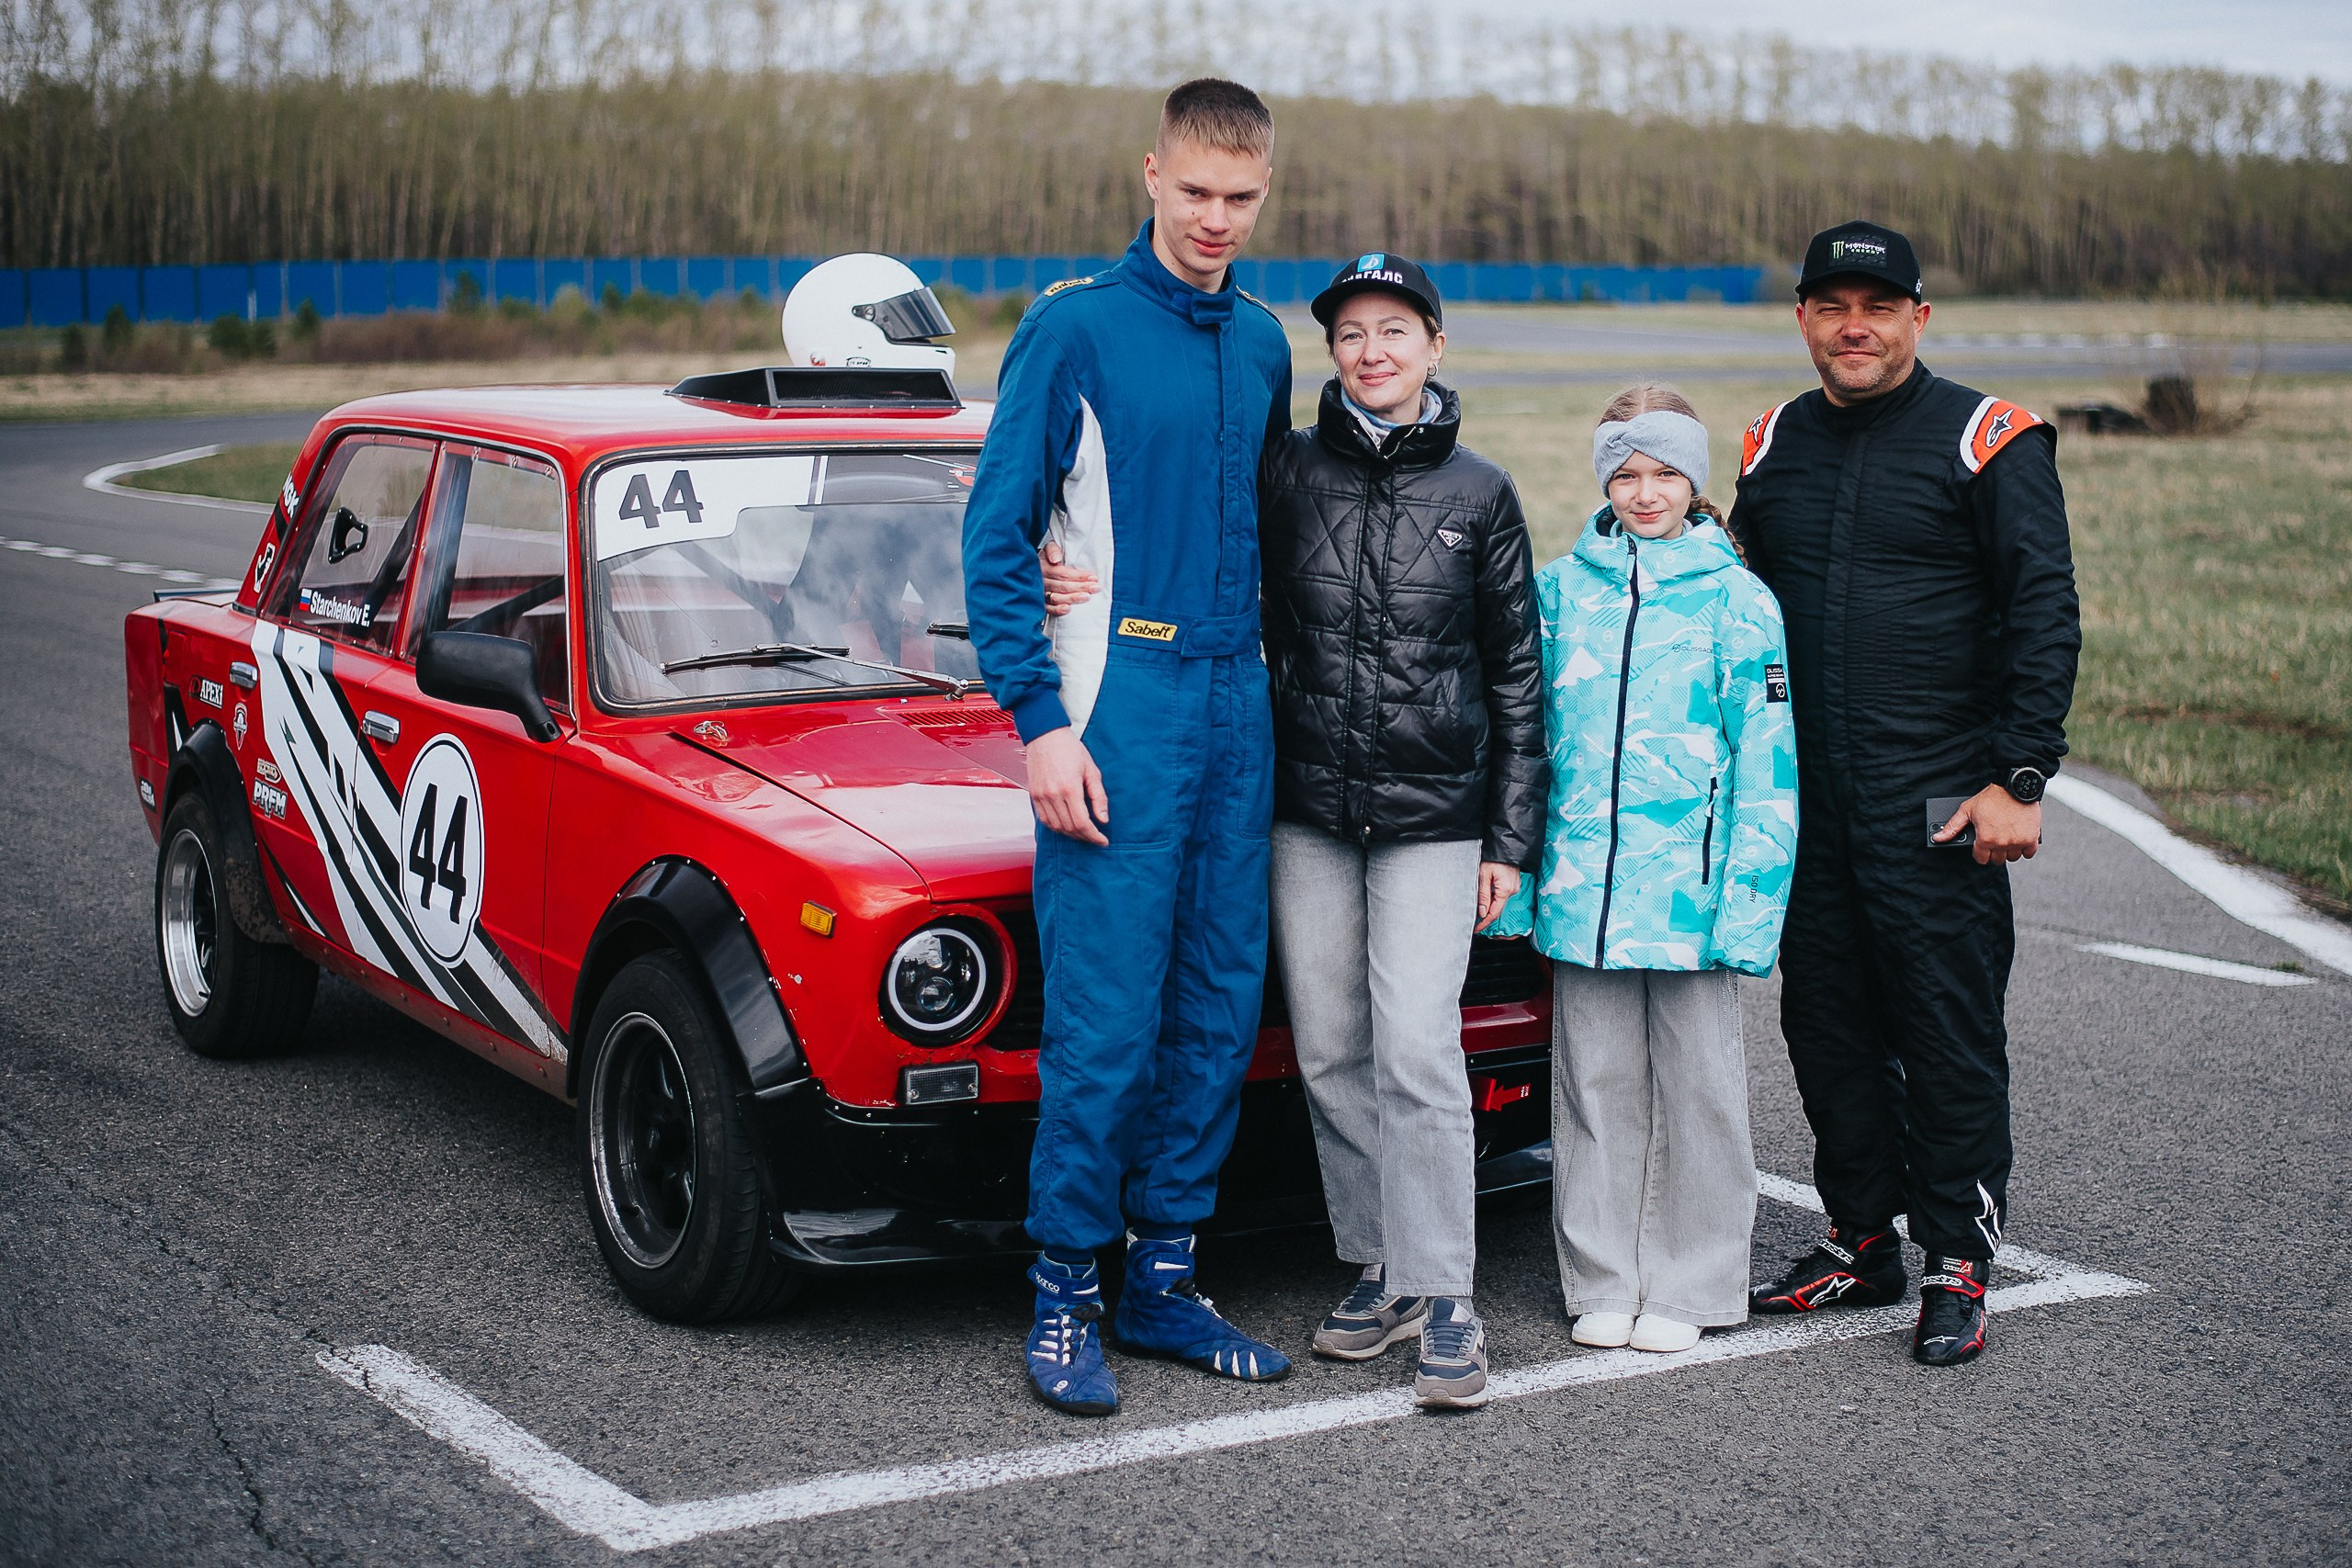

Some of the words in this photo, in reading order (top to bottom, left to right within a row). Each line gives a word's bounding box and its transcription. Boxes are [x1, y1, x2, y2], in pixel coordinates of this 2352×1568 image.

[618, 469, 705, 529] 44
[310, 591, 363, 625] Starchenkov
[1125, 621, 1170, 638] Sabelt
[408, 782, 469, 925] 44
